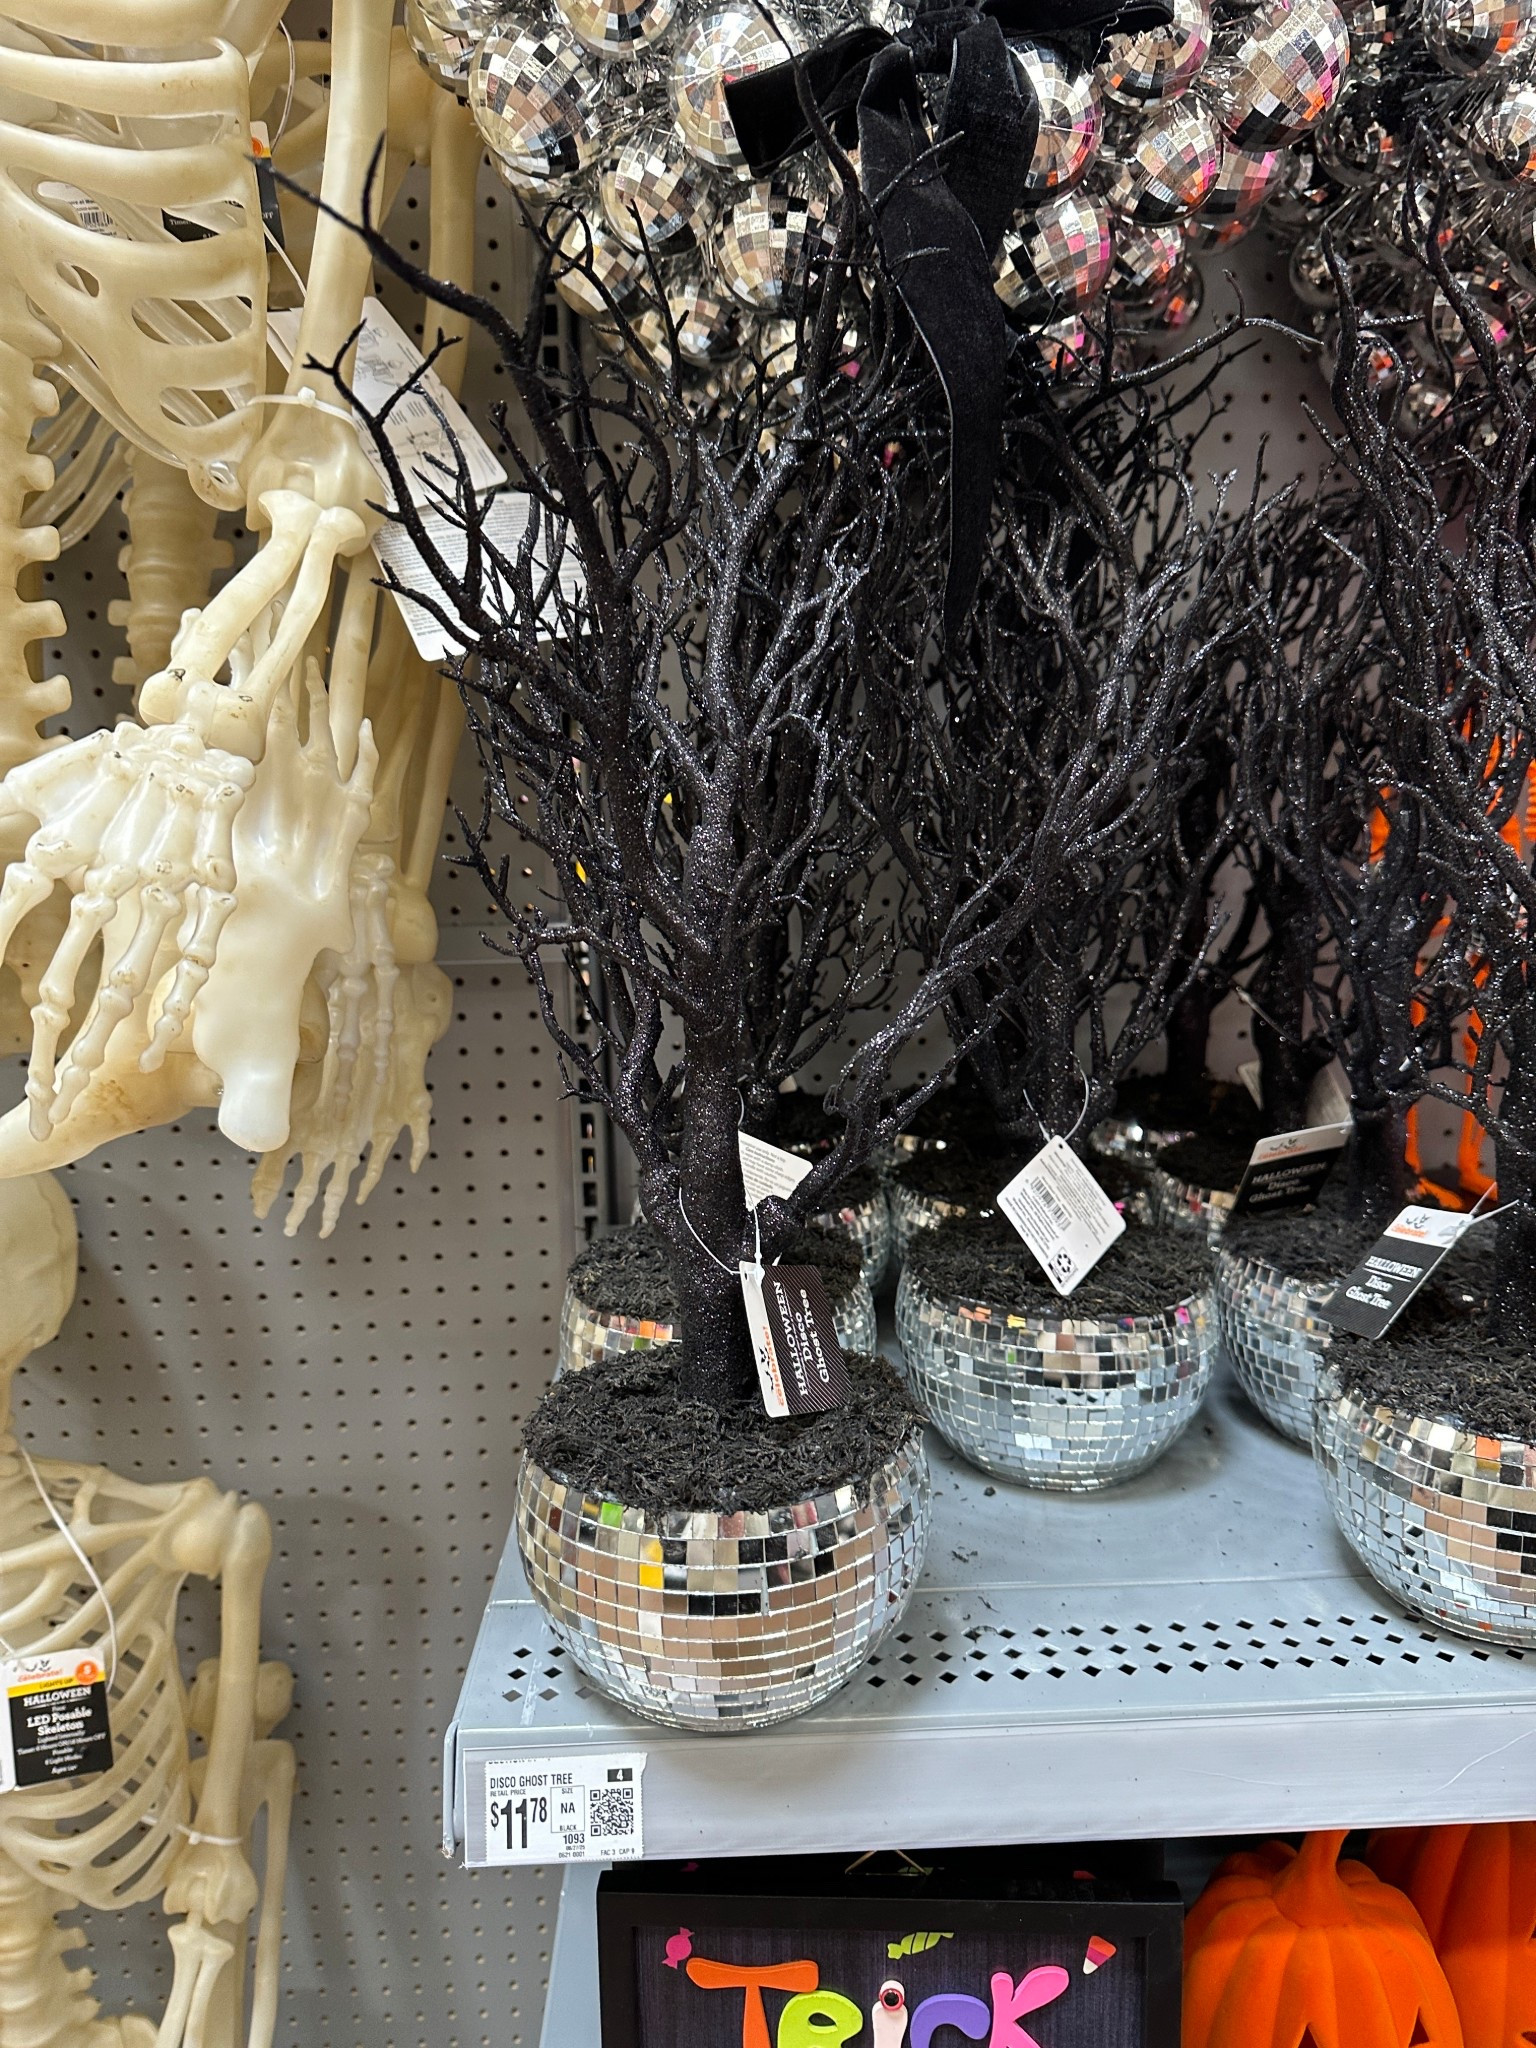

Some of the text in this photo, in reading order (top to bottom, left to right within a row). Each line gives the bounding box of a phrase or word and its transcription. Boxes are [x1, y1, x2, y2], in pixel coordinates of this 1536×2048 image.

[1252, 1162, 1328, 1184] HALLOWEEN
[1268, 1179, 1299, 1191] Disco
[1249, 1185, 1310, 1203] Ghost Tree
[1365, 1256, 1423, 1278] HALLOWEEN
[1365, 1275, 1394, 1292] Disco
[1346, 1286, 1392, 1309] Ghost Tree
[773, 1281, 808, 1396] HALLOWEEN
[796, 1312, 814, 1362] Disco
[800, 1289, 829, 1382] Ghost Tree
[762, 1326, 784, 1406] celebrate!
[23, 1686, 92, 1707] HALLOWEEN
[26, 1715, 51, 1728] LED
[52, 1708, 93, 1723] Posable
[37, 1720, 84, 1736] Skeleton
[490, 1773, 573, 1789] DISCO GHOST TREE
[616, 1769, 624, 1781] 4
[490, 1787, 527, 1797] RETAIL PRICE
[560, 1802, 576, 1814] NA
[559, 1824, 577, 1832] BLACK
[563, 1833, 585, 1845] 1093
[600, 1849, 611, 1857] FAC
[618, 1847, 630, 1856] CAP
